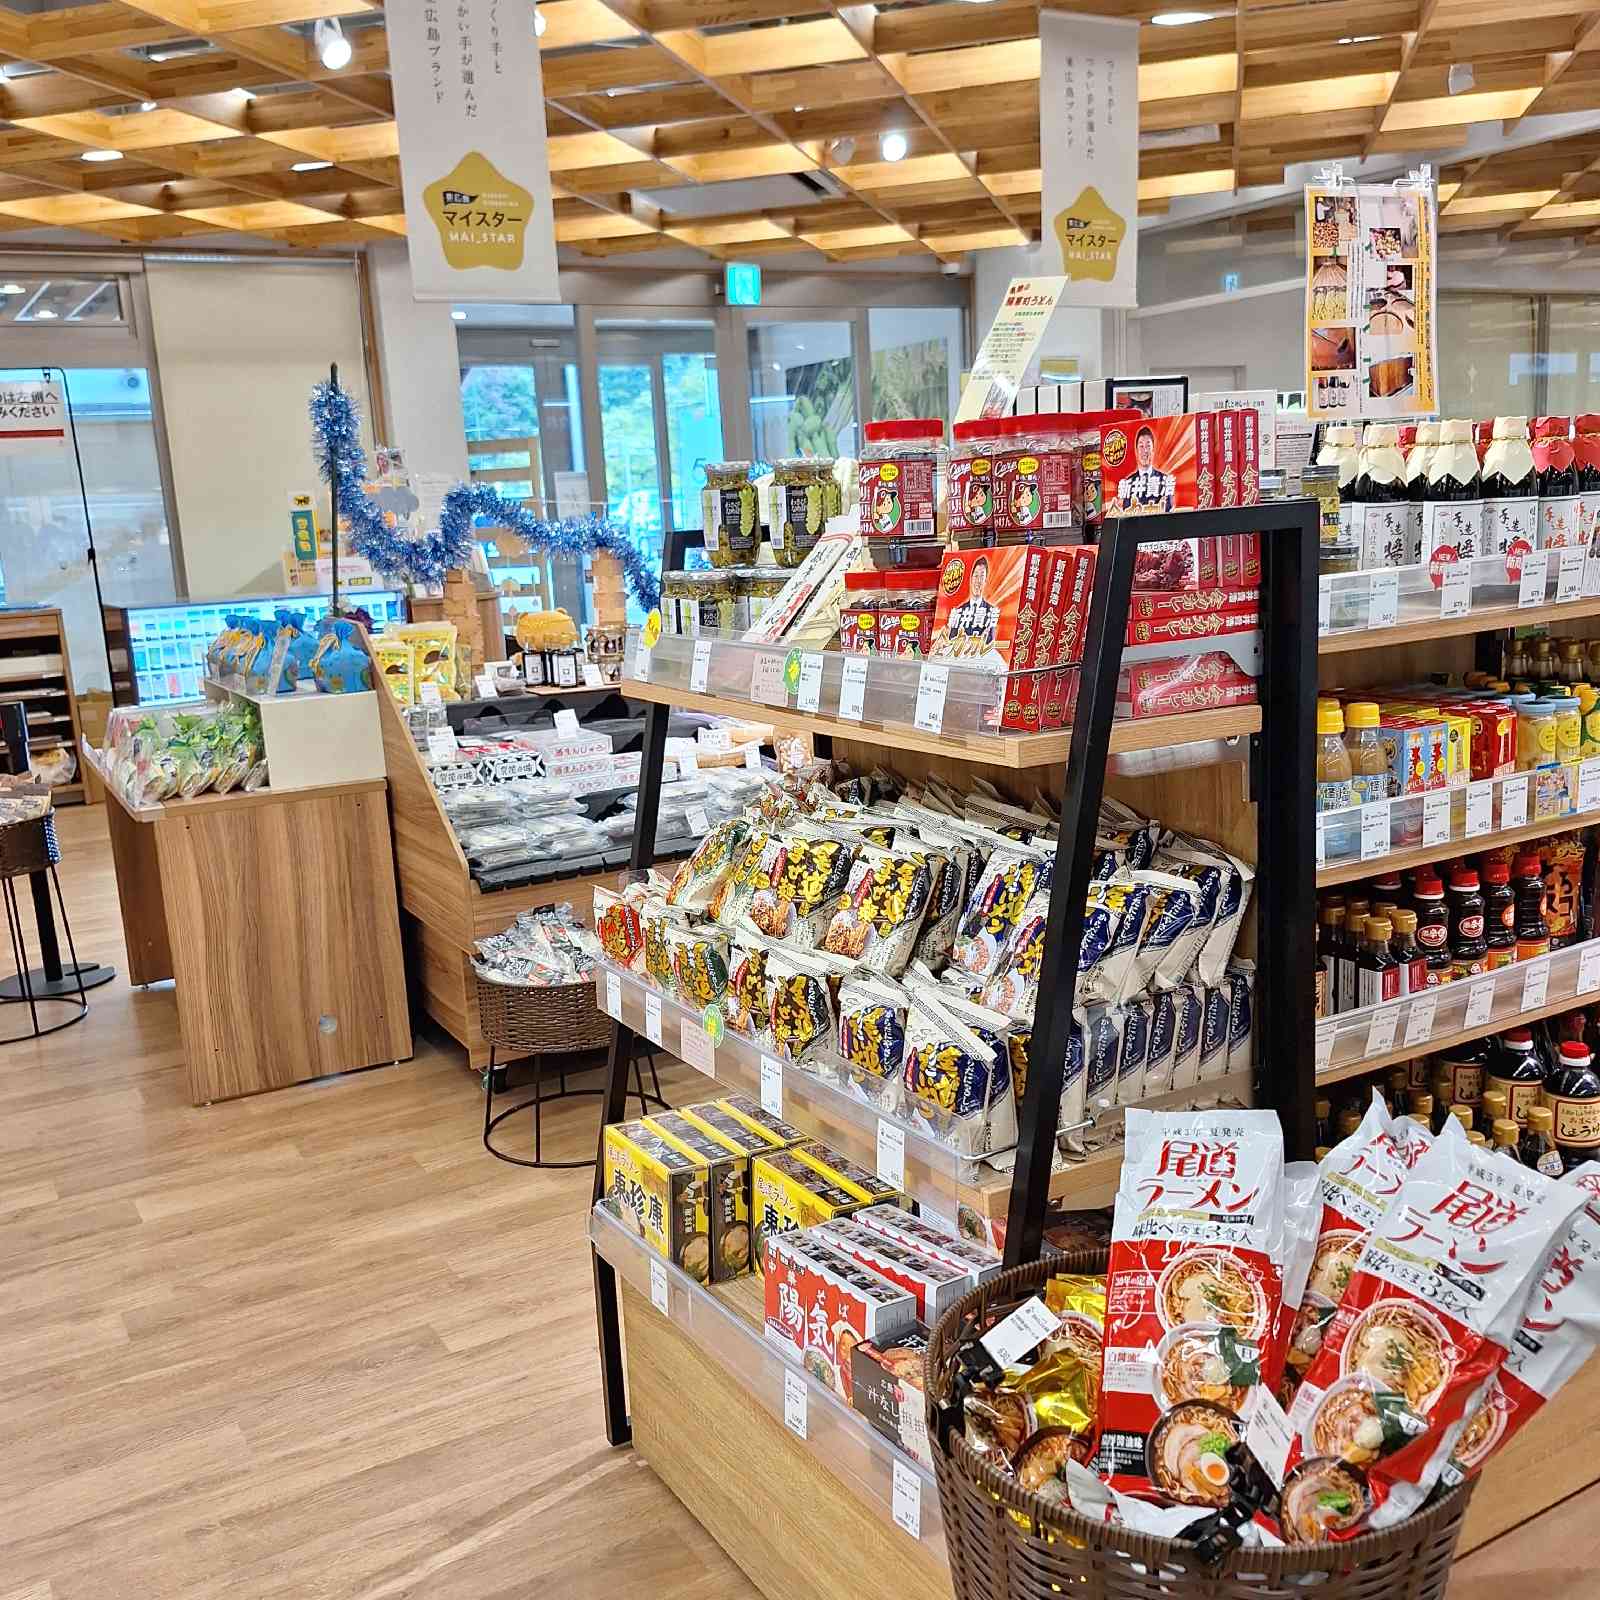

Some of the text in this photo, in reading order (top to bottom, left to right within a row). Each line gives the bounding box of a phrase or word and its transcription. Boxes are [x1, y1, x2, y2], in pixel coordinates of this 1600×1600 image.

[457, 0, 477, 118] かい手が選んだ
[442, 211, 523, 228] マイスター
[1065, 233, 1118, 248] マイスター
[1118, 474, 1177, 499] 新井貴浩
[948, 607, 1001, 629] 新井貴浩
[1157, 1140, 1240, 1178] 尾道
[1137, 1178, 1261, 1213] ラーメン
[778, 1280, 836, 1357] 陽気
